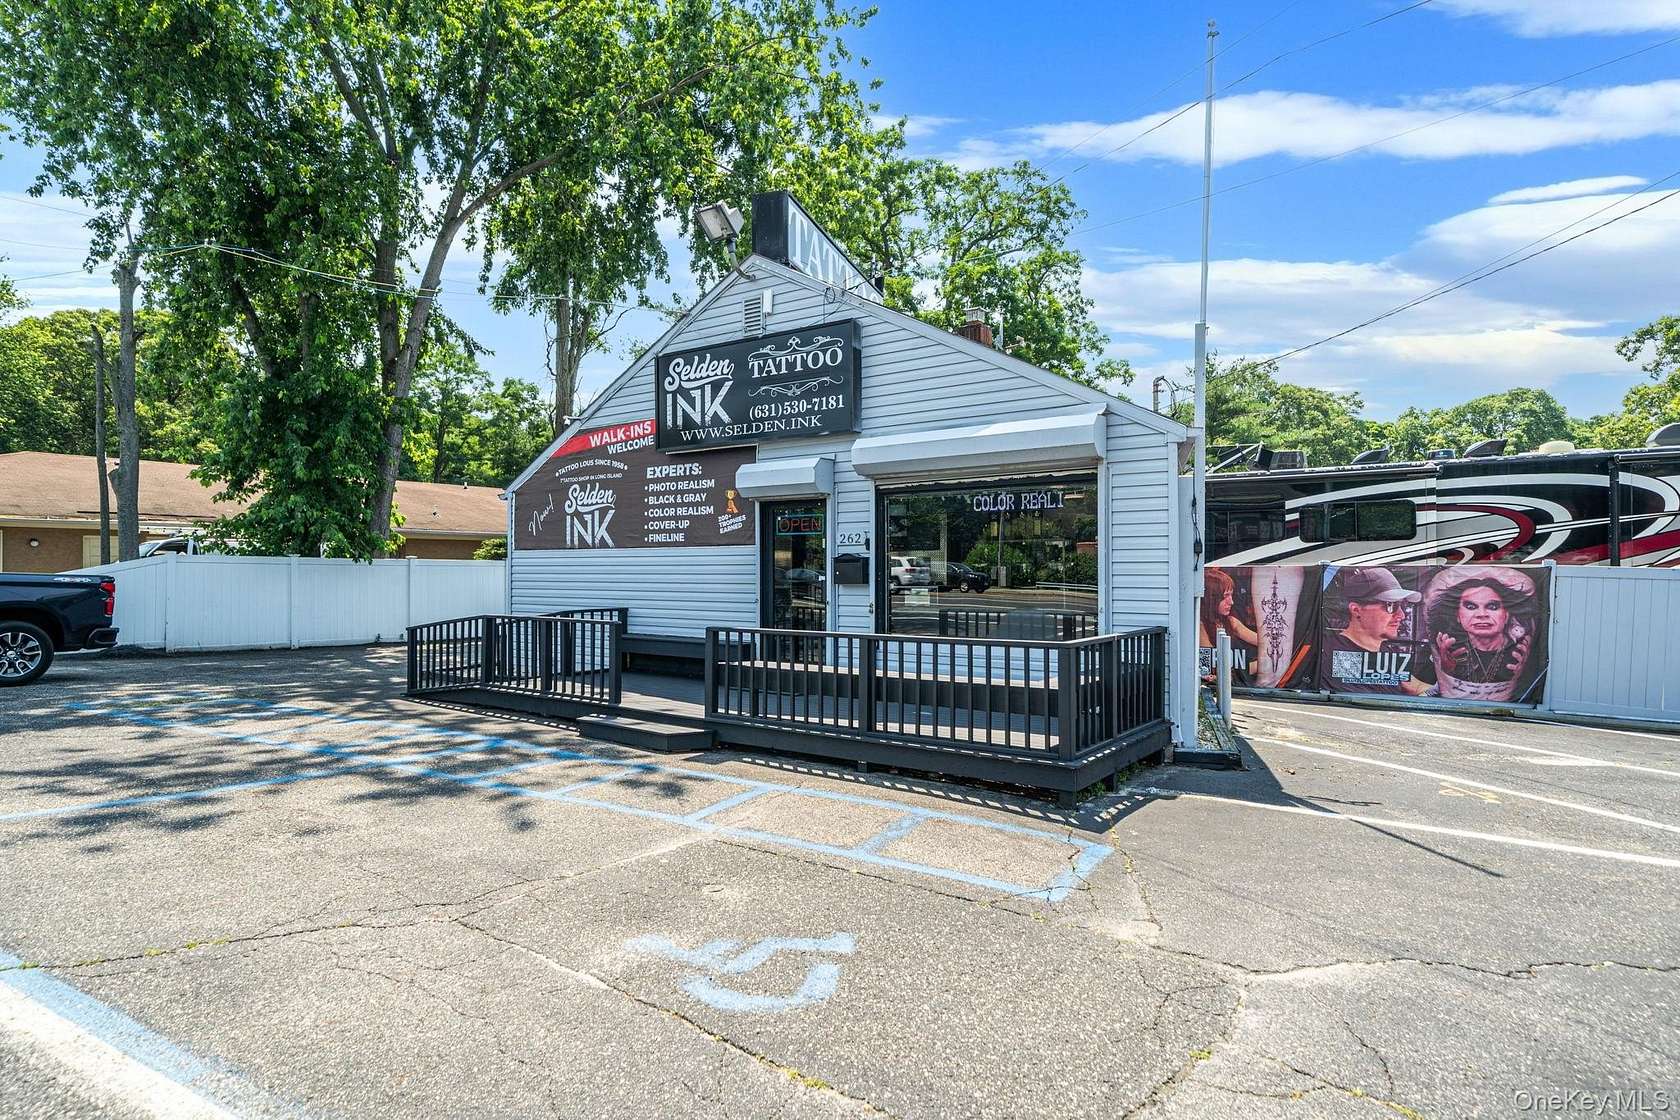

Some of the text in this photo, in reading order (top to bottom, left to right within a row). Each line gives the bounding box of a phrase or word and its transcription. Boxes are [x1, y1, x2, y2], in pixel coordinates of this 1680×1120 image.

[749, 345, 843, 379] TATTOO
[664, 354, 735, 392] Selden
[666, 381, 734, 429] INK
[749, 394, 845, 421] (631)530-7181
[589, 421, 652, 448] WALK-INS
[680, 415, 822, 441] WWW.SELDEN.INK
[607, 435, 655, 455] WELCOME
[558, 462, 579, 475] TATTOO
[594, 458, 611, 466] SINCE
[646, 462, 702, 479] EXPERTS:
[648, 479, 715, 492] PHOTO REALISM
[564, 482, 616, 514] Selden
[648, 493, 707, 505] BLACK & GRAY
[973, 493, 1015, 512] COLOR
[648, 505, 714, 517] COLOR REALISM
[566, 509, 616, 549] INK
[648, 519, 690, 530] COVER-UP
[780, 518, 821, 531] OPEN
[648, 532, 685, 543] FINELINE
[840, 533, 861, 544] 262
[1363, 652, 1411, 675] LUIZ
[1362, 672, 1409, 681] LOPES
